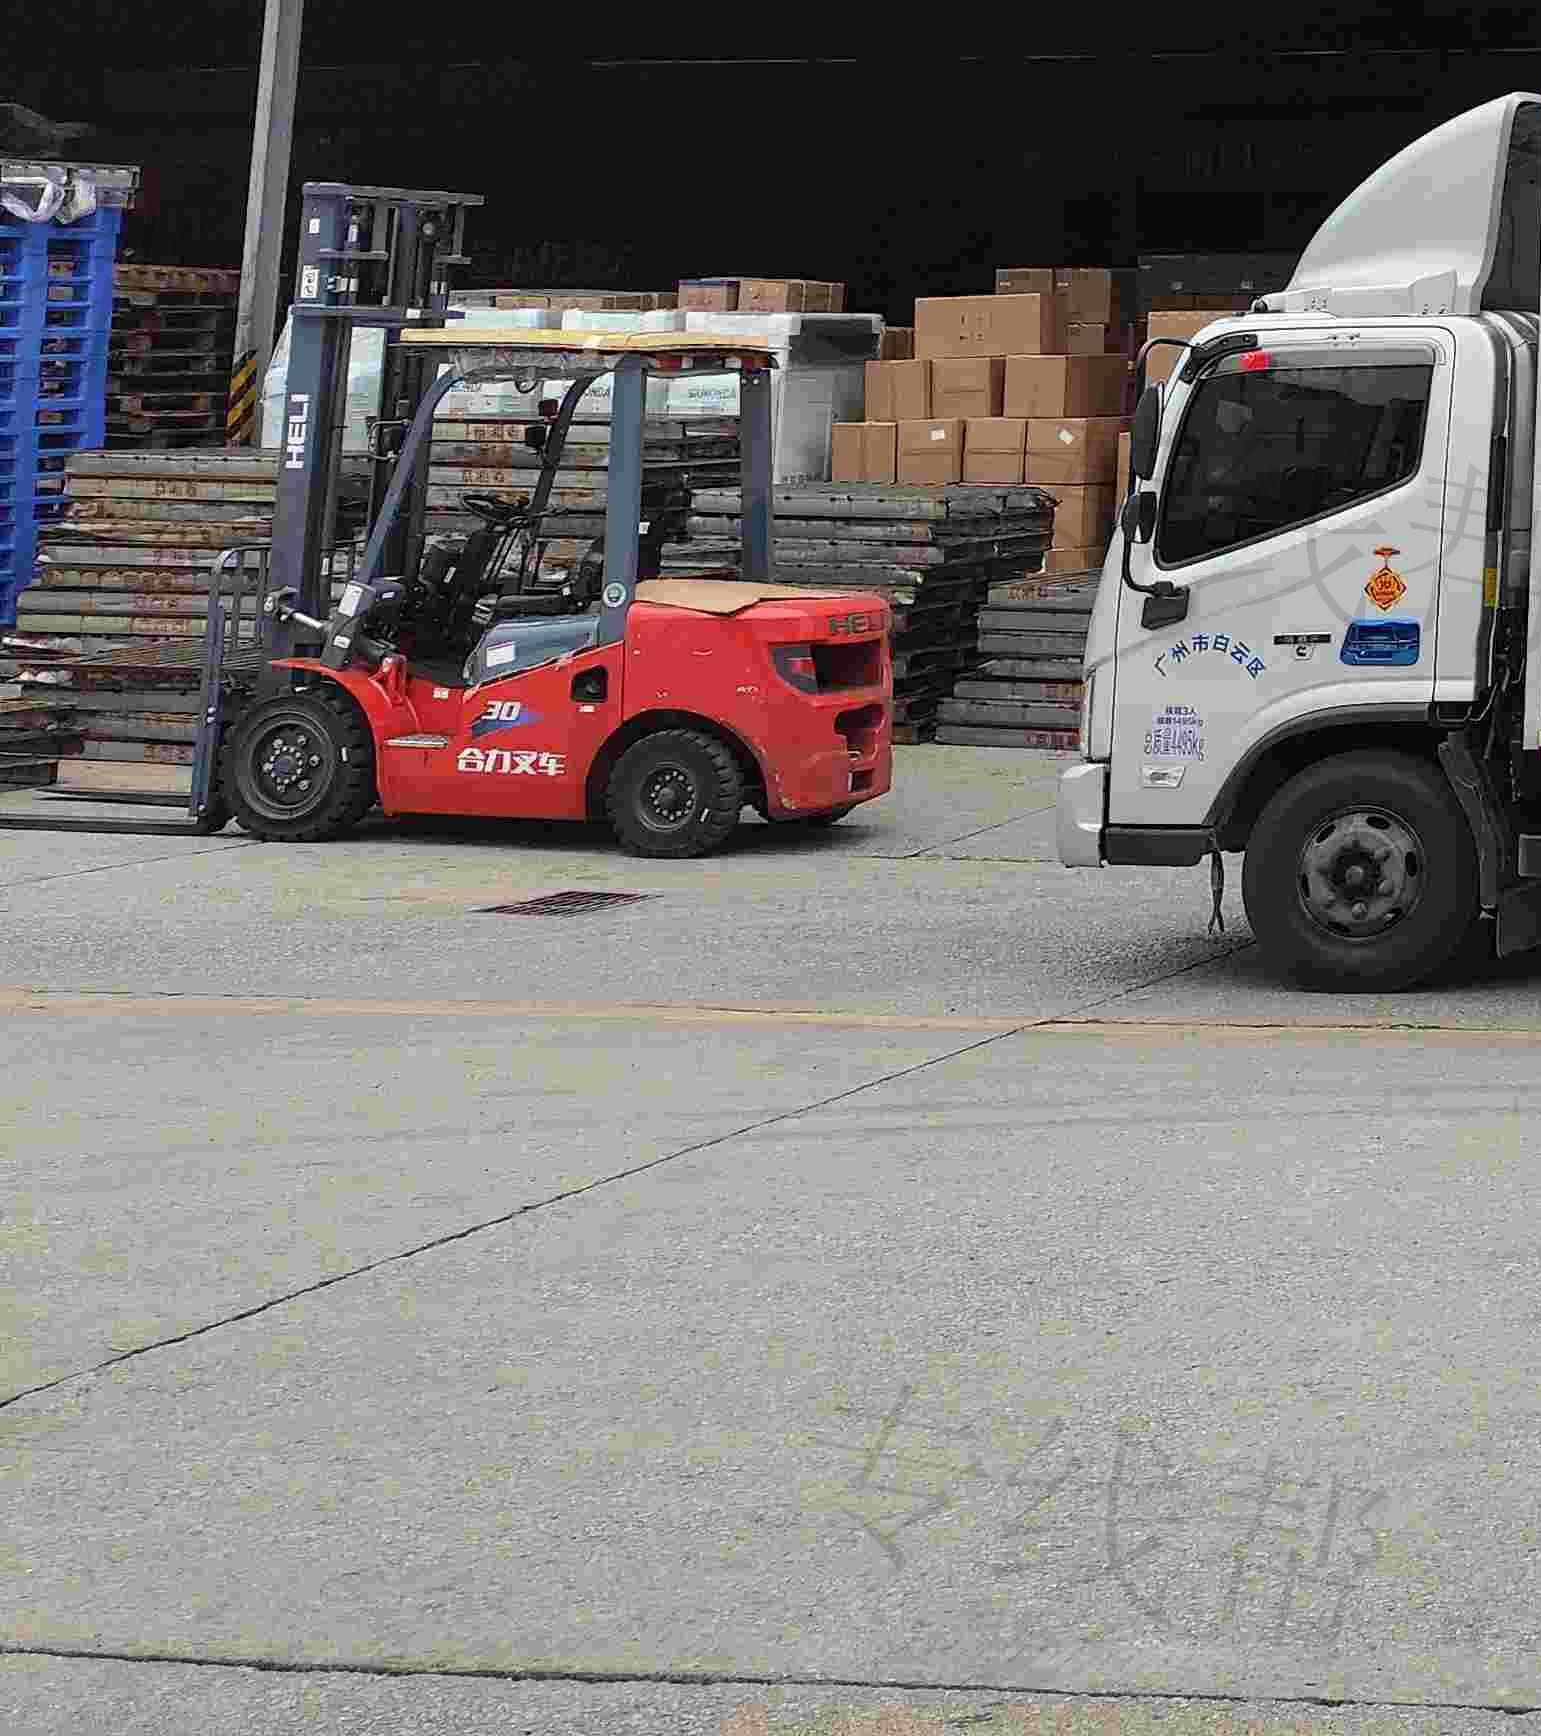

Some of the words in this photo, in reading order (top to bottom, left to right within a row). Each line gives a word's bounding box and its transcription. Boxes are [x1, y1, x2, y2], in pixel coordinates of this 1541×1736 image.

[284, 393, 310, 469] HELI
[1153, 632, 1267, 680] 广州市白云区
[481, 700, 521, 721] 30
[456, 747, 567, 777] 合力叉车
